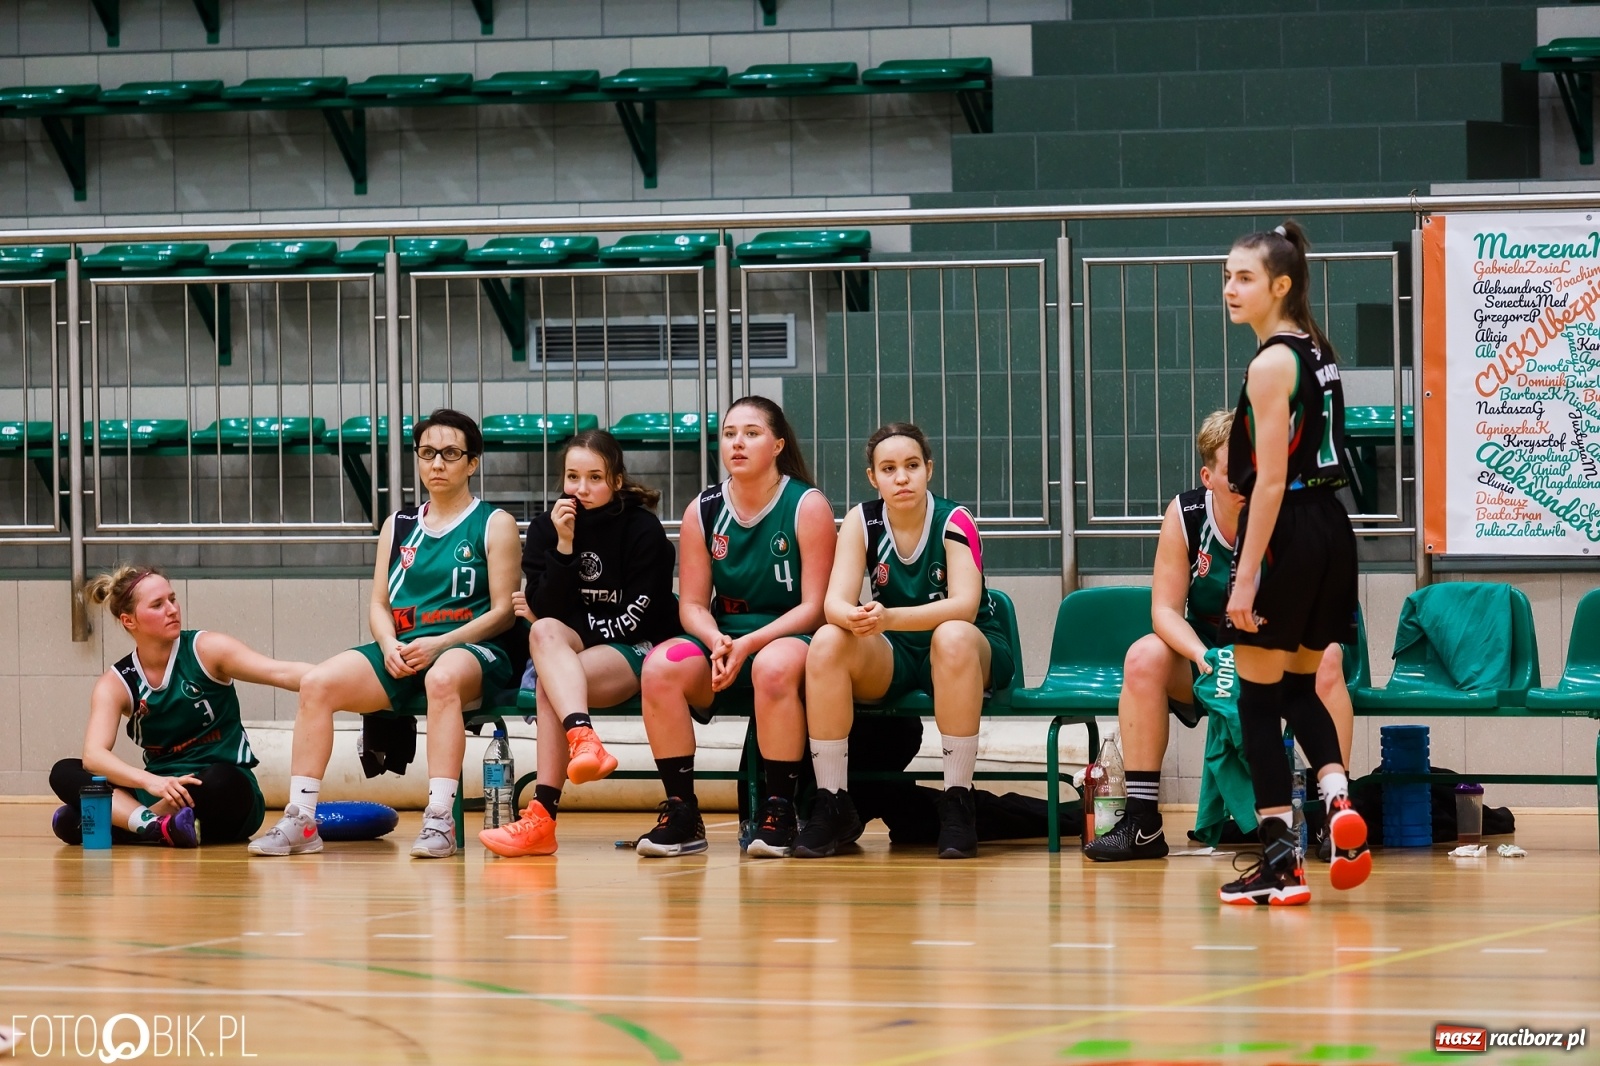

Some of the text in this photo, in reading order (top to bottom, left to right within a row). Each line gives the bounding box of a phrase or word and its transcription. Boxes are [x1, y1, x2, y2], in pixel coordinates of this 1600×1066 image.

[1473, 279, 1552, 295] AleksandraS
[1485, 292, 1569, 308] SenectusMed
[1474, 308, 1541, 328] GrzegorzP
[1475, 279, 1600, 398] CUKUbezpi
[1475, 328, 1508, 349] Alicja
[1475, 344, 1497, 358] Ala
[1526, 358, 1569, 372] Dorota
[1516, 372, 1566, 388] Dominik
[1499, 386, 1563, 401] BartoszK
[1475, 400, 1545, 421] NastaszaG
[1475, 420, 1551, 441] AgnieszkaK
[1502, 432, 1567, 453] Krzysztof
[1514, 447, 1580, 463] KarolinaD
[1531, 462, 1571, 477] AniaP
[1477, 470, 1515, 495] Elunia
[1475, 507, 1542, 521] BeataFran
[451, 566, 476, 598] 13
[774, 560, 793, 592] 4
[1215, 648, 1235, 698] CHUDA
[194, 699, 215, 727] 3
